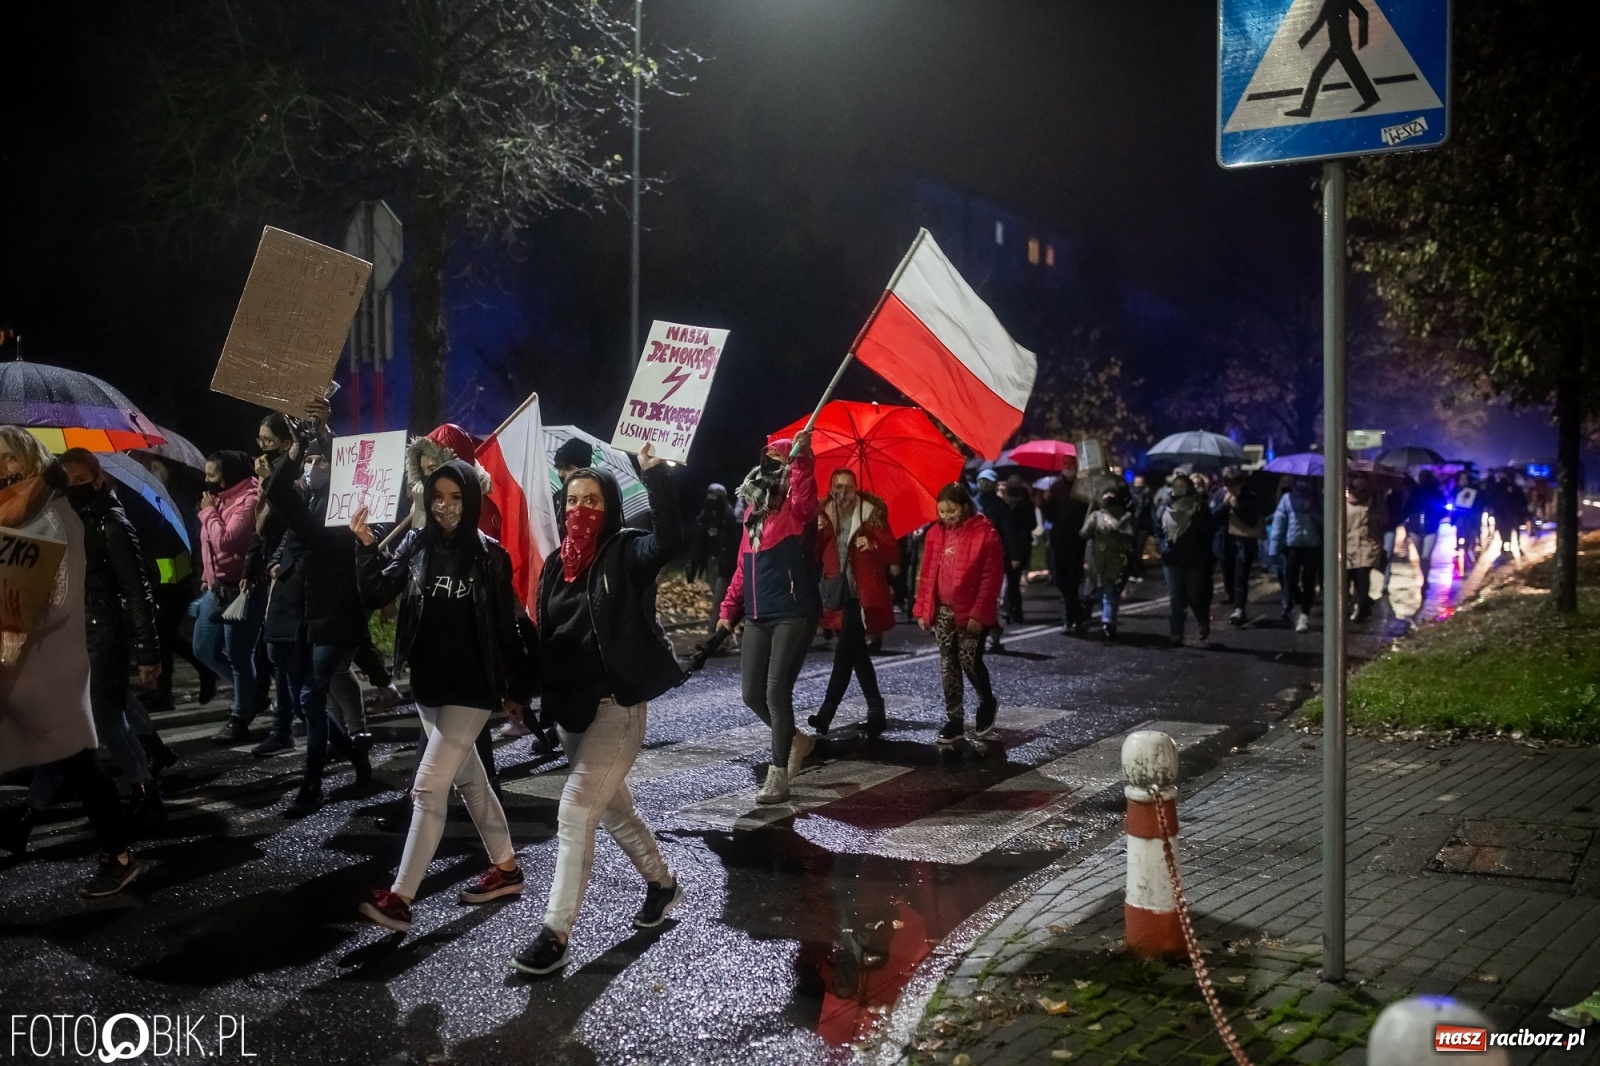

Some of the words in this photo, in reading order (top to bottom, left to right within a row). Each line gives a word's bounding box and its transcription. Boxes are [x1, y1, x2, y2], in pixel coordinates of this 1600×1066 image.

[666, 326, 709, 346] NASZA
[629, 399, 648, 419] TO
[619, 421, 671, 443] USUNIEMY
